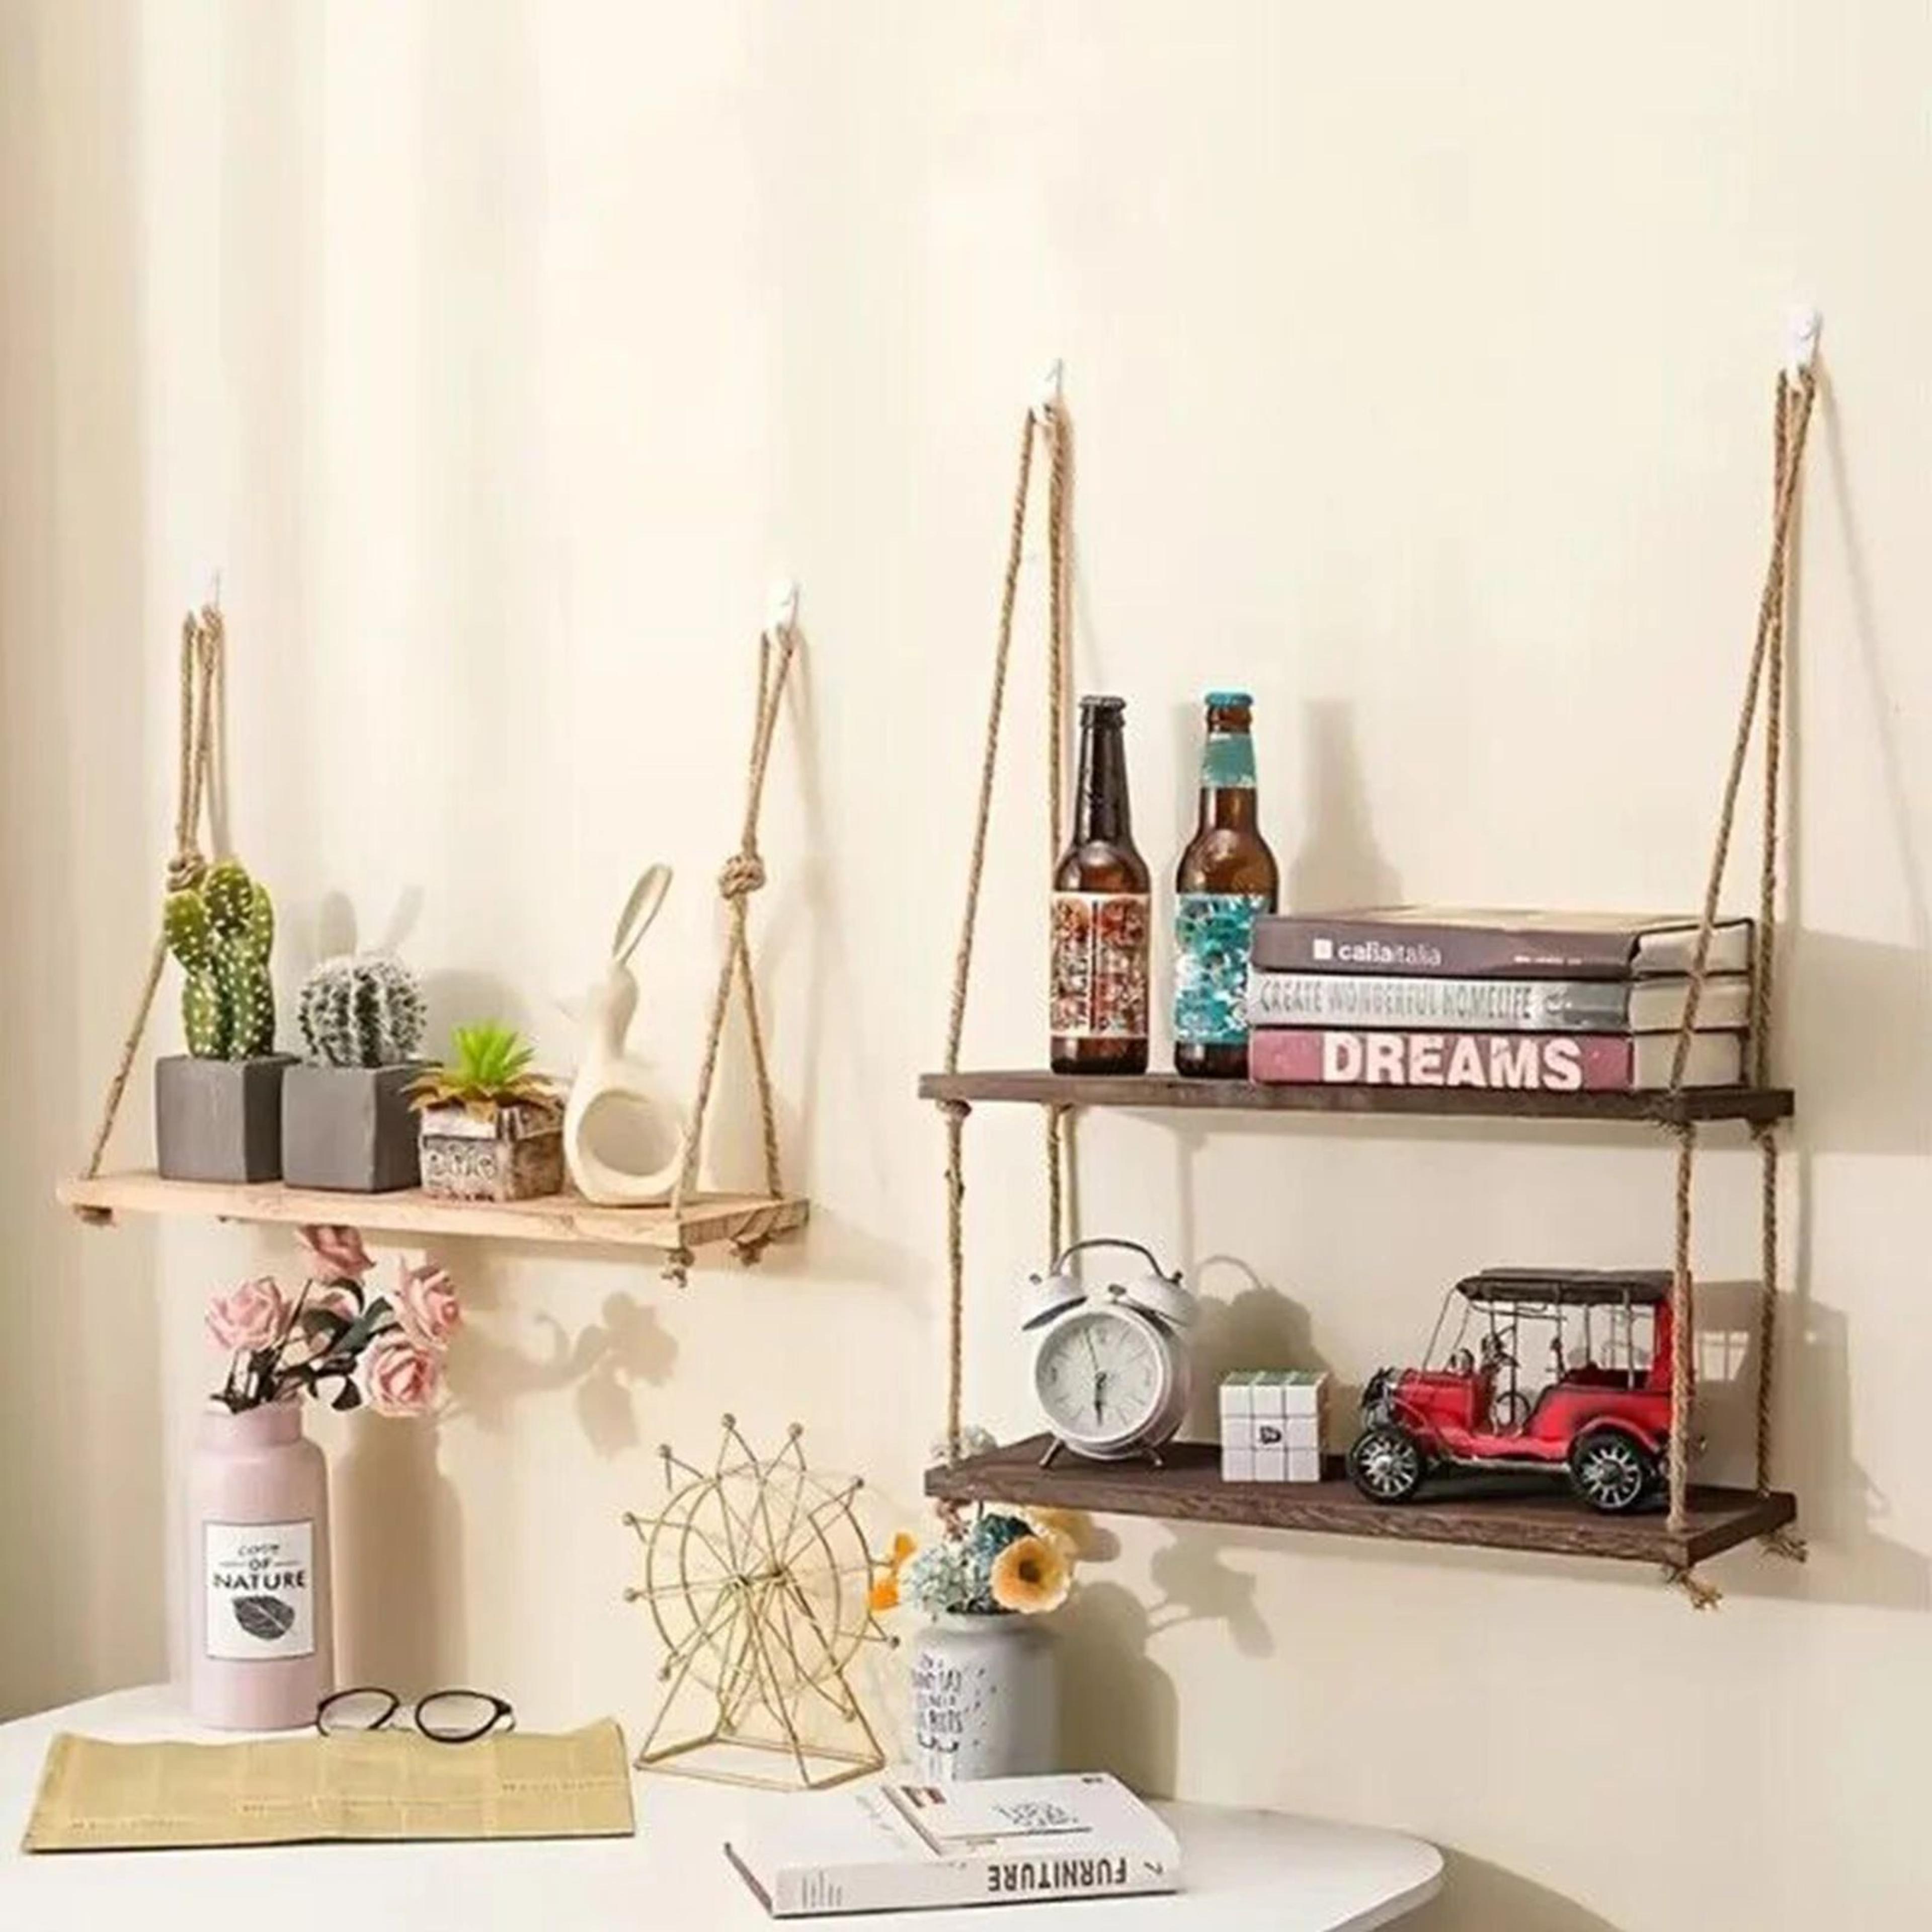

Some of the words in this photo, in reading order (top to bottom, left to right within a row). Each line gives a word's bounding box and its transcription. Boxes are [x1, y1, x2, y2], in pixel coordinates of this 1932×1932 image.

[1323, 1031, 1583, 1091] DREAMS
[213, 1569, 306, 1590] NATURE
[987, 1857, 1127, 1891] FURNITURE
